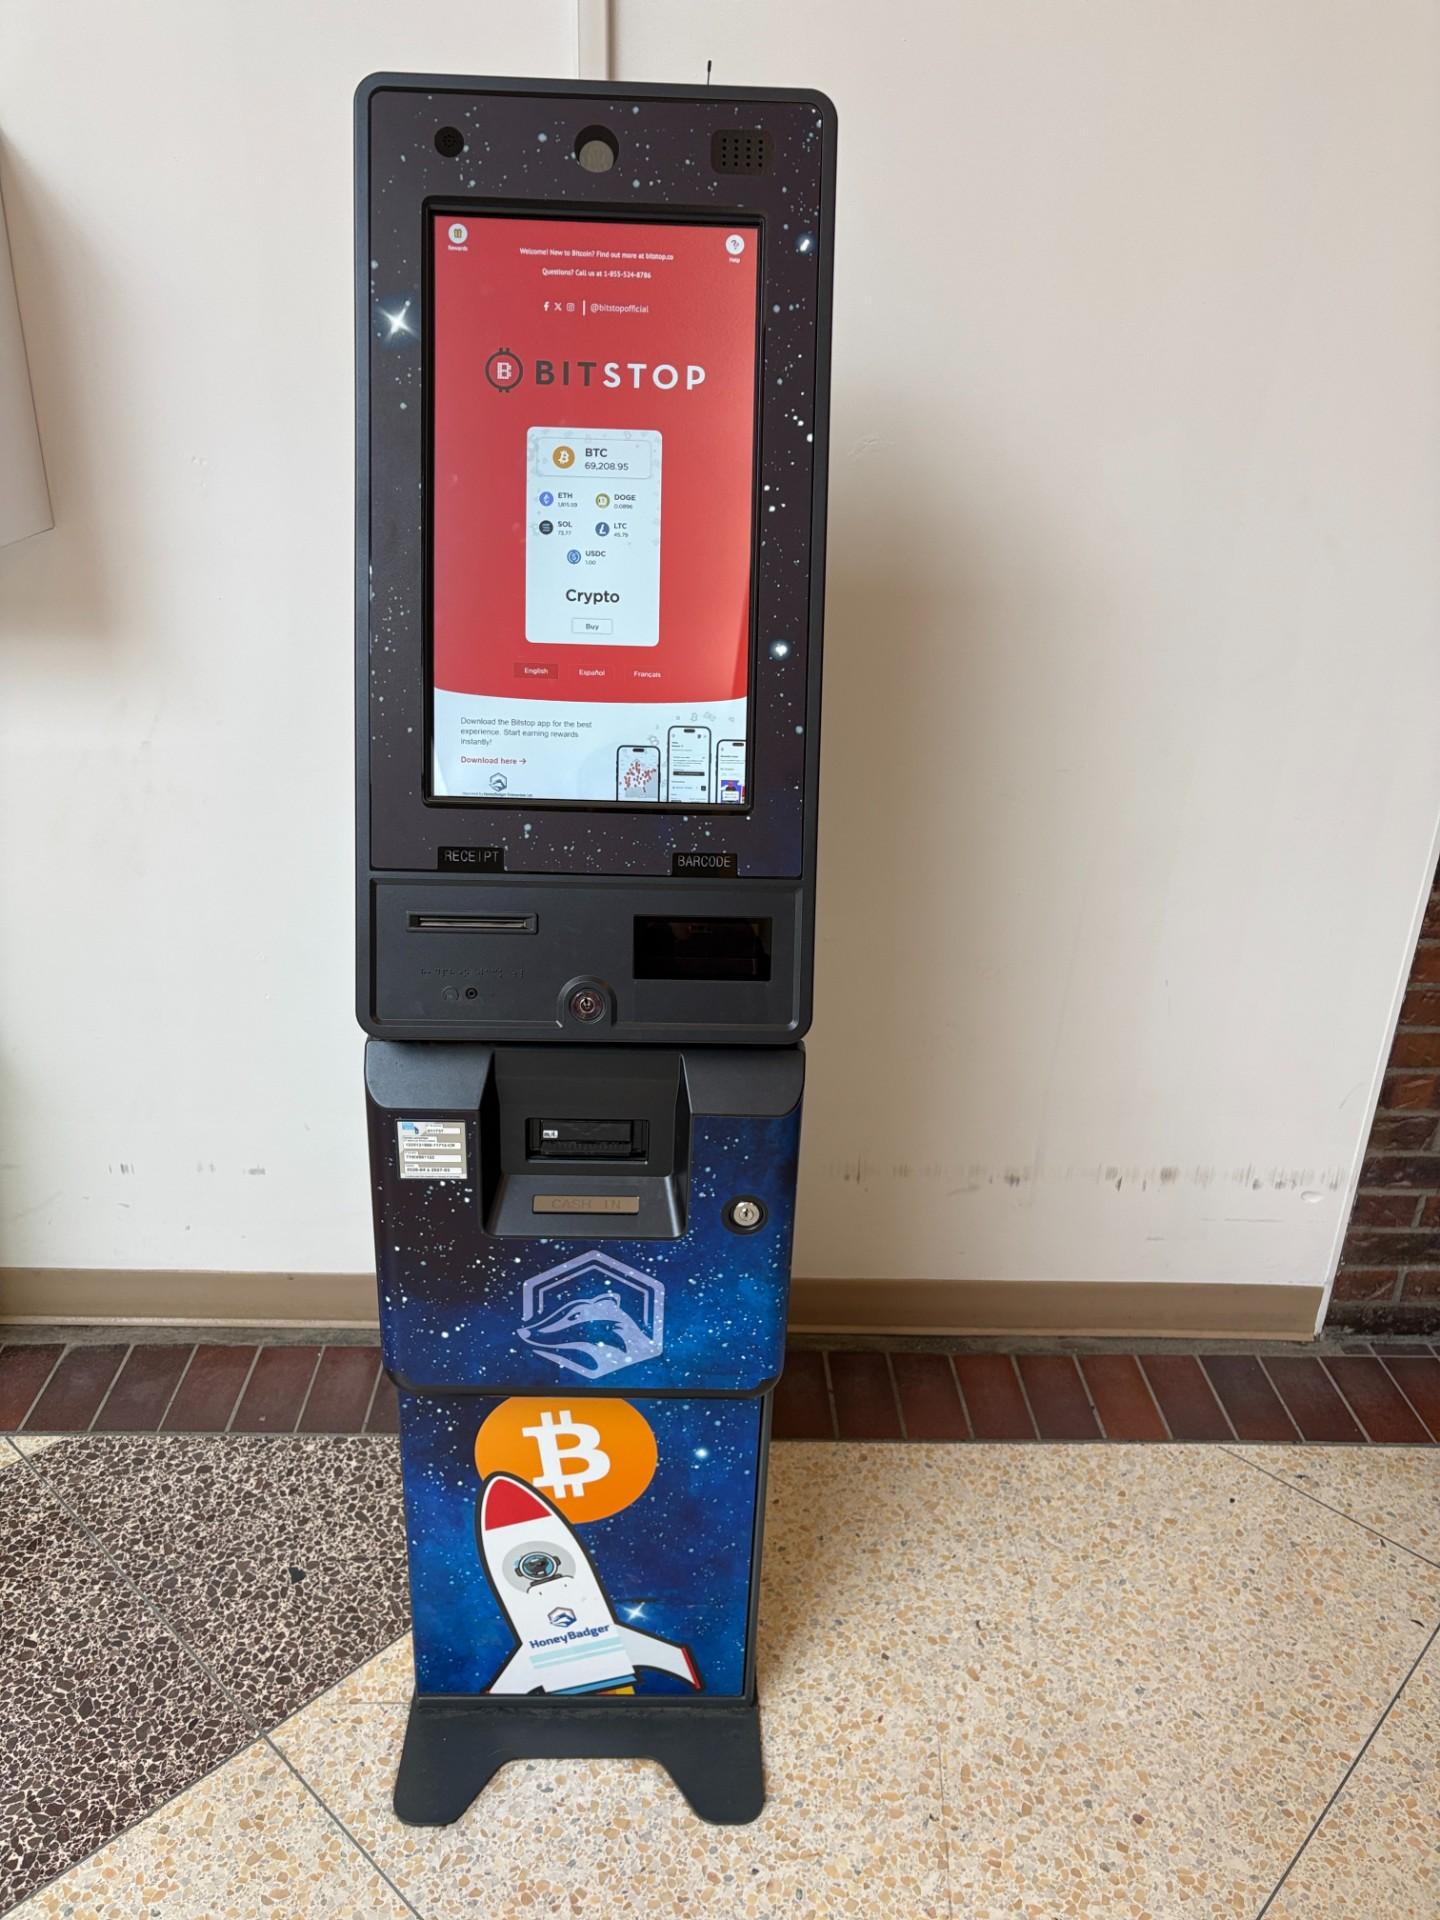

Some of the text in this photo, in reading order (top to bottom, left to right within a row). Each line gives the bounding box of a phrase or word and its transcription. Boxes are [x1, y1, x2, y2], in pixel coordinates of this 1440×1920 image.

[520, 248, 548, 256] Welcome!
[646, 254, 674, 262] bitstop.co
[542, 267, 574, 276] Questions?
[575, 268, 587, 276] Call
[591, 304, 649, 314] @bitstopofficial
[535, 360, 706, 390] BITSTOP
[585, 448, 607, 458] BTC
[585, 462, 629, 471] 69,208.95
[566, 589, 620, 605] Crypto
[586, 623, 599, 631] Buy
[524, 666, 548, 675] English
[579, 668, 606, 677] Español
[460, 717, 496, 726] Download
[511, 719, 535, 728] Bitstop
[460, 728, 500, 737] experience.
[522, 730, 549, 738] earning
[550, 730, 579, 738] rewards
[460, 738, 492, 747] instantly!
[460, 756, 517, 765] Download here
[444, 850, 499, 863] RECEIPT
[677, 855, 731, 868] BARCODE
[552, 1199, 621, 1209] CASH IN
[529, 1624, 610, 1649] HoneyBadger
